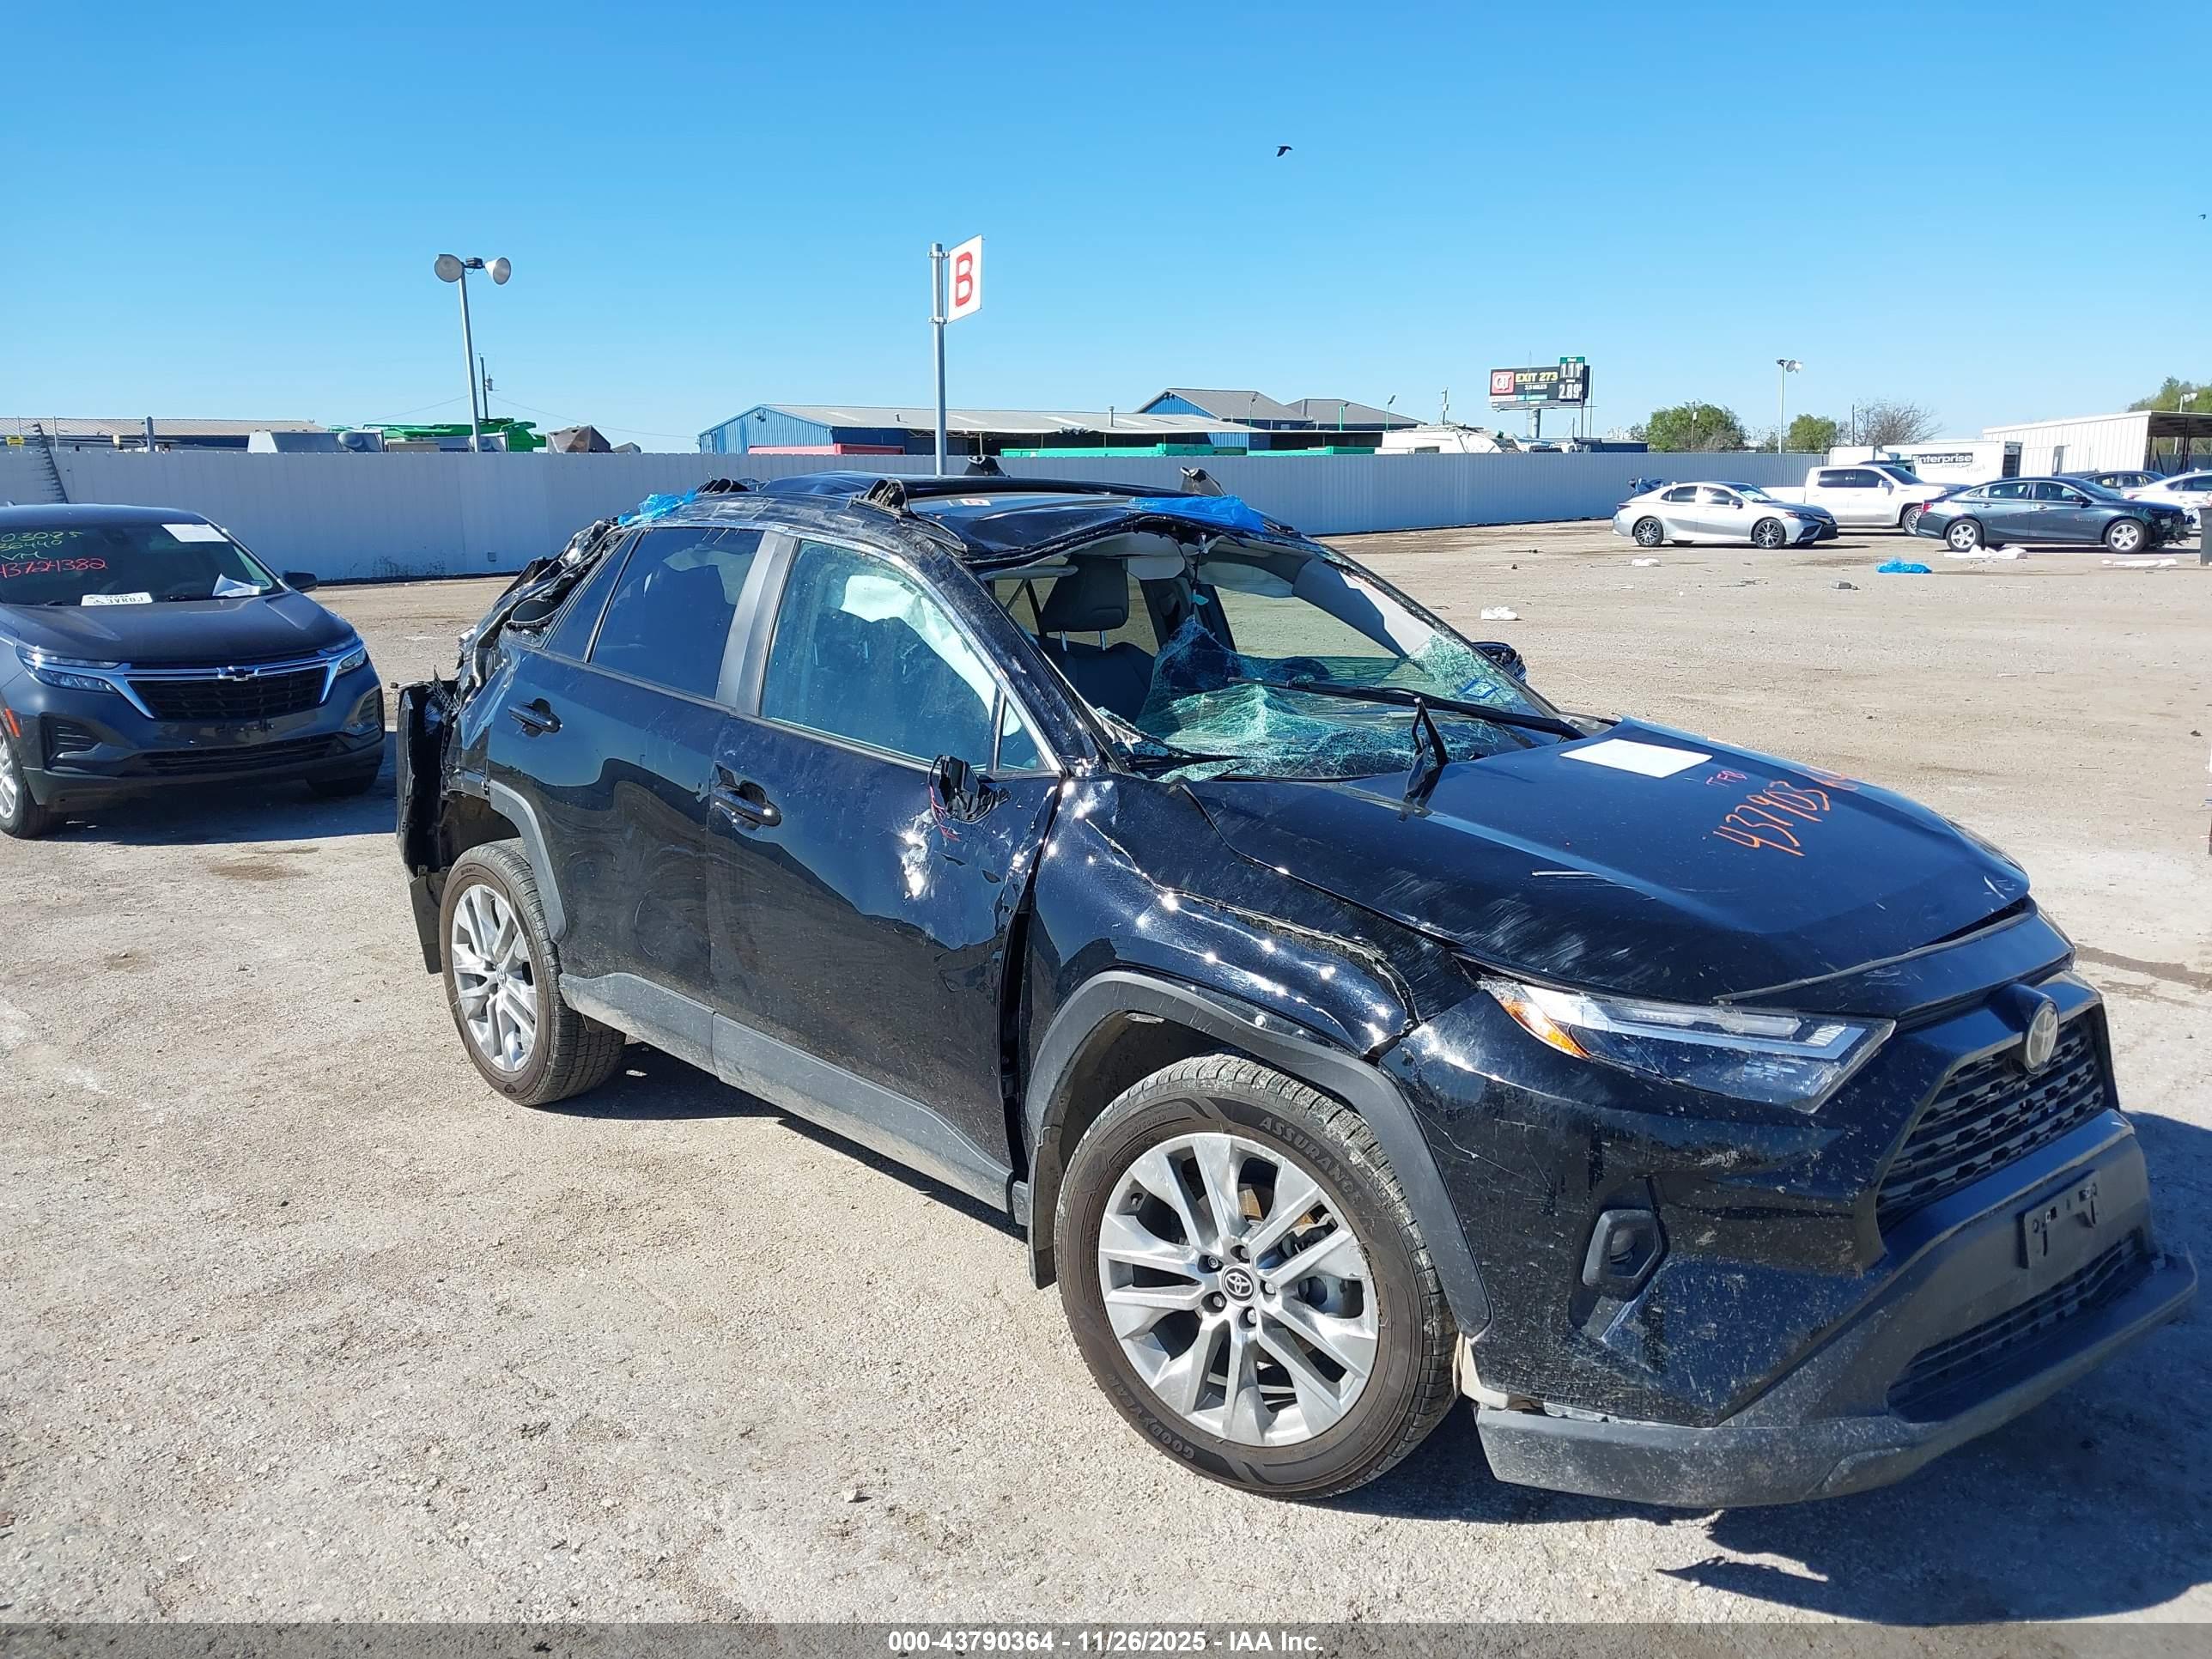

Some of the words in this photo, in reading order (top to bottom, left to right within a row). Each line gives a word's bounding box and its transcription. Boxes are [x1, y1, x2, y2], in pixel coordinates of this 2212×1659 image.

[956, 252, 973, 307] B
[1494, 375, 1511, 391] QT
[1516, 373, 1538, 383] EXIT
[1539, 372, 1559, 382] 273
